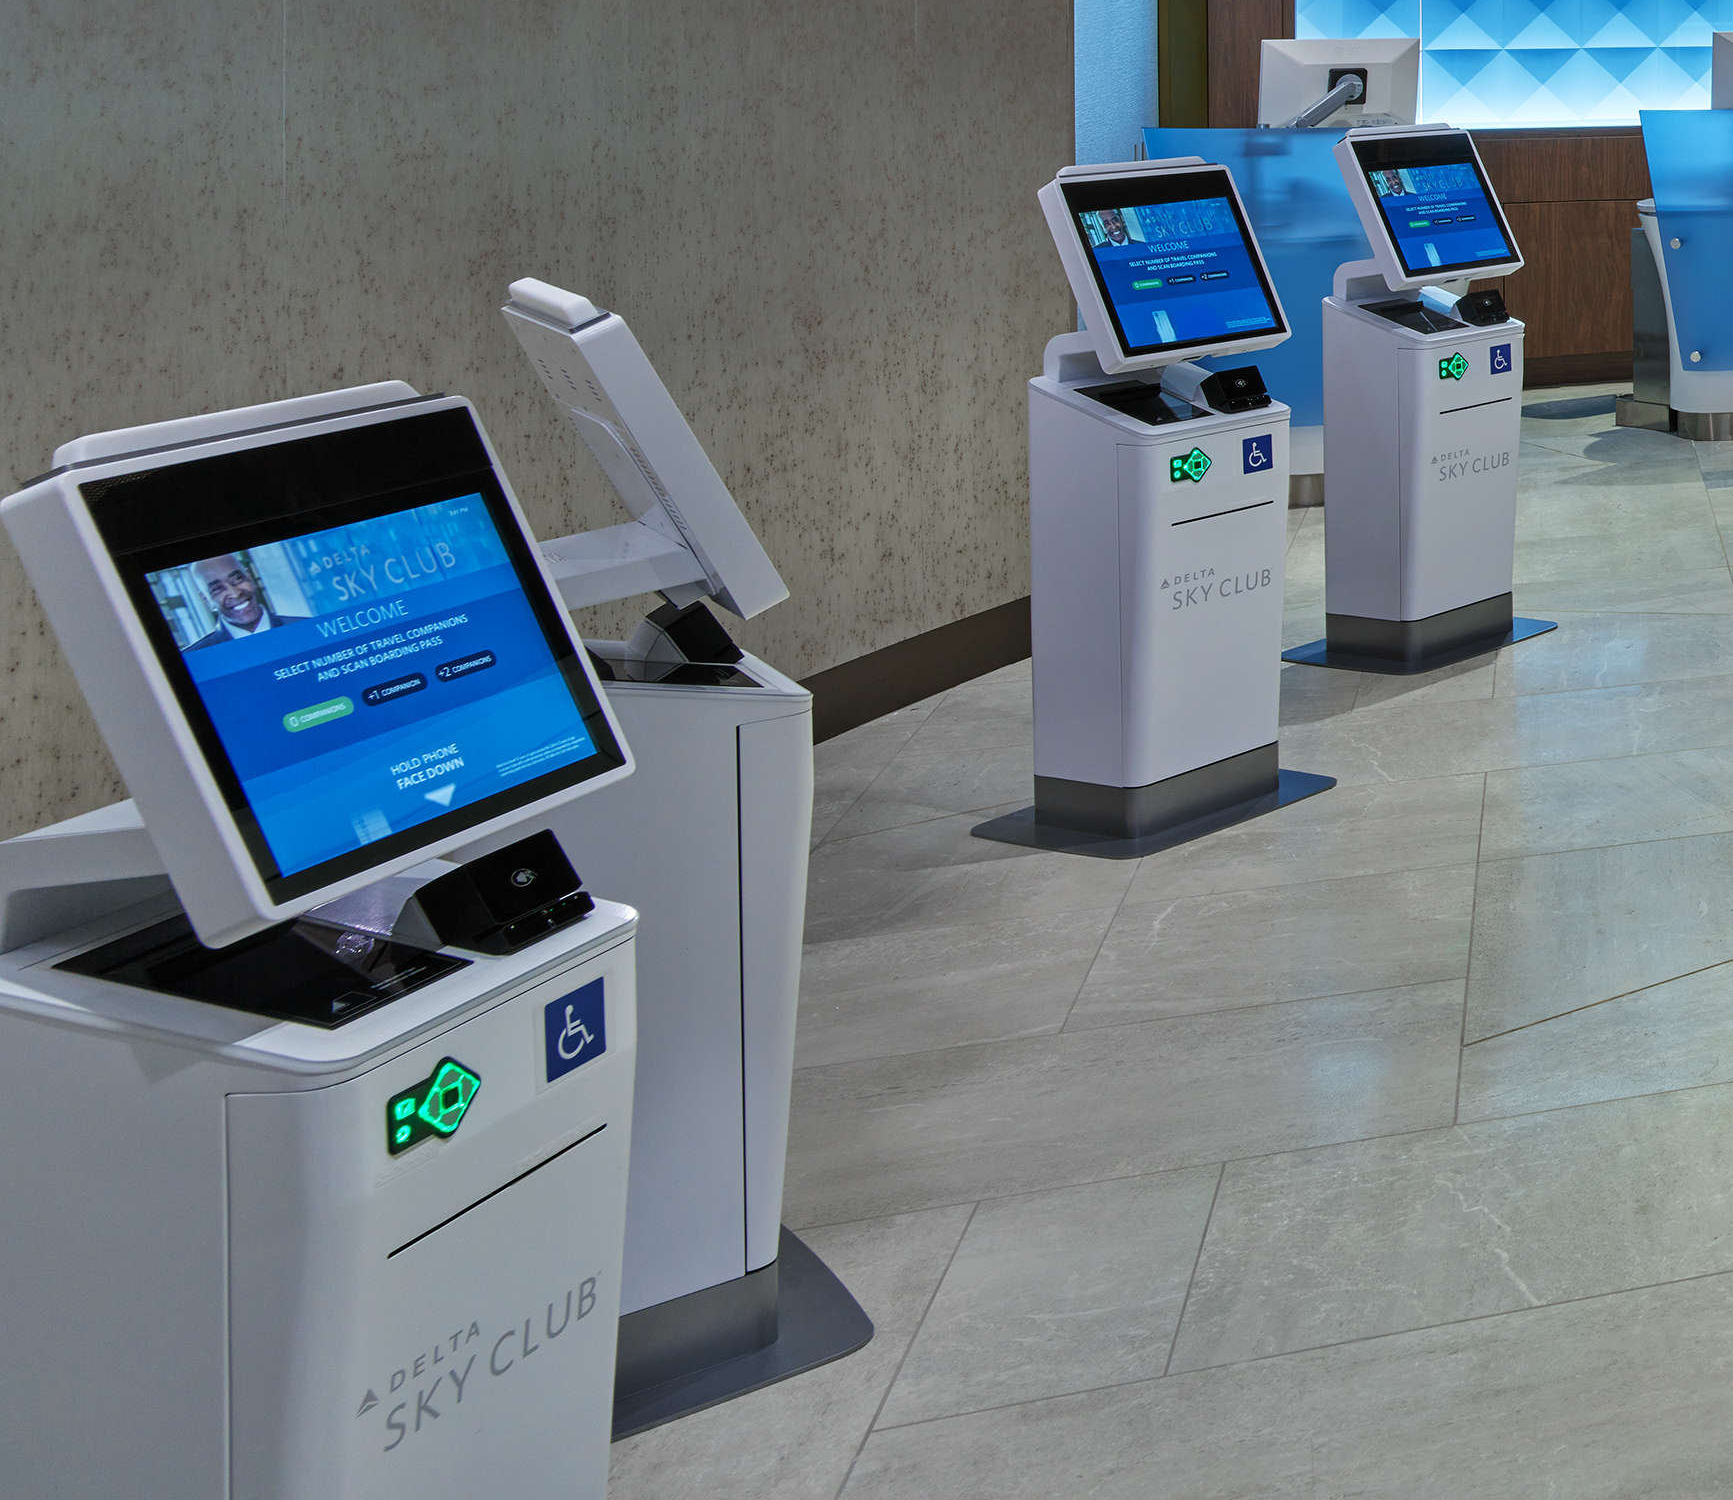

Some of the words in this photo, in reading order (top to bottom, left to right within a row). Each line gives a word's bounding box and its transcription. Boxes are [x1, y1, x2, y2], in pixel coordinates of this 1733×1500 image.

[1155, 222, 1176, 238] SKY
[1178, 217, 1213, 235] CLUB
[1147, 240, 1190, 253] WELCOME
[1438, 460, 1469, 482] SKY
[1472, 451, 1510, 474] CLUB
[1440, 448, 1470, 462] DELTA
[323, 543, 372, 571] DELTA
[331, 566, 379, 602] SKY
[384, 541, 457, 585] CLUB
[1172, 582, 1213, 610] SKY
[1219, 568, 1271, 598] CLUB
[1173, 567, 1216, 586] DELTA
[315, 599, 410, 638] WELCOME
[273, 660, 311, 681] SELECT
[311, 648, 356, 670] NUMBER
[355, 642, 369, 656] OF
[369, 633, 407, 653] TRAVEL
[406, 613, 469, 641] COMPANIONS
[317, 667, 346, 683] AND
[343, 659, 370, 676] SCAN
[370, 642, 420, 667] BOARDING
[419, 635, 443, 651] PASS
[438, 666, 452, 678] +2
[451, 655, 493, 675] COMPANIONS
[367, 690, 381, 701] +1
[380, 678, 421, 698] COMPANION
[300, 702, 347, 724] COMPANIONS
[390, 757, 421, 776] HOLD
[423, 742, 460, 765] PHONE
[396, 771, 428, 790] FACE
[427, 756, 466, 780] DOWN
[382, 1353, 477, 1453] SKY
[489, 1276, 597, 1377] CLUB
[389, 1320, 481, 1394] DELTA
